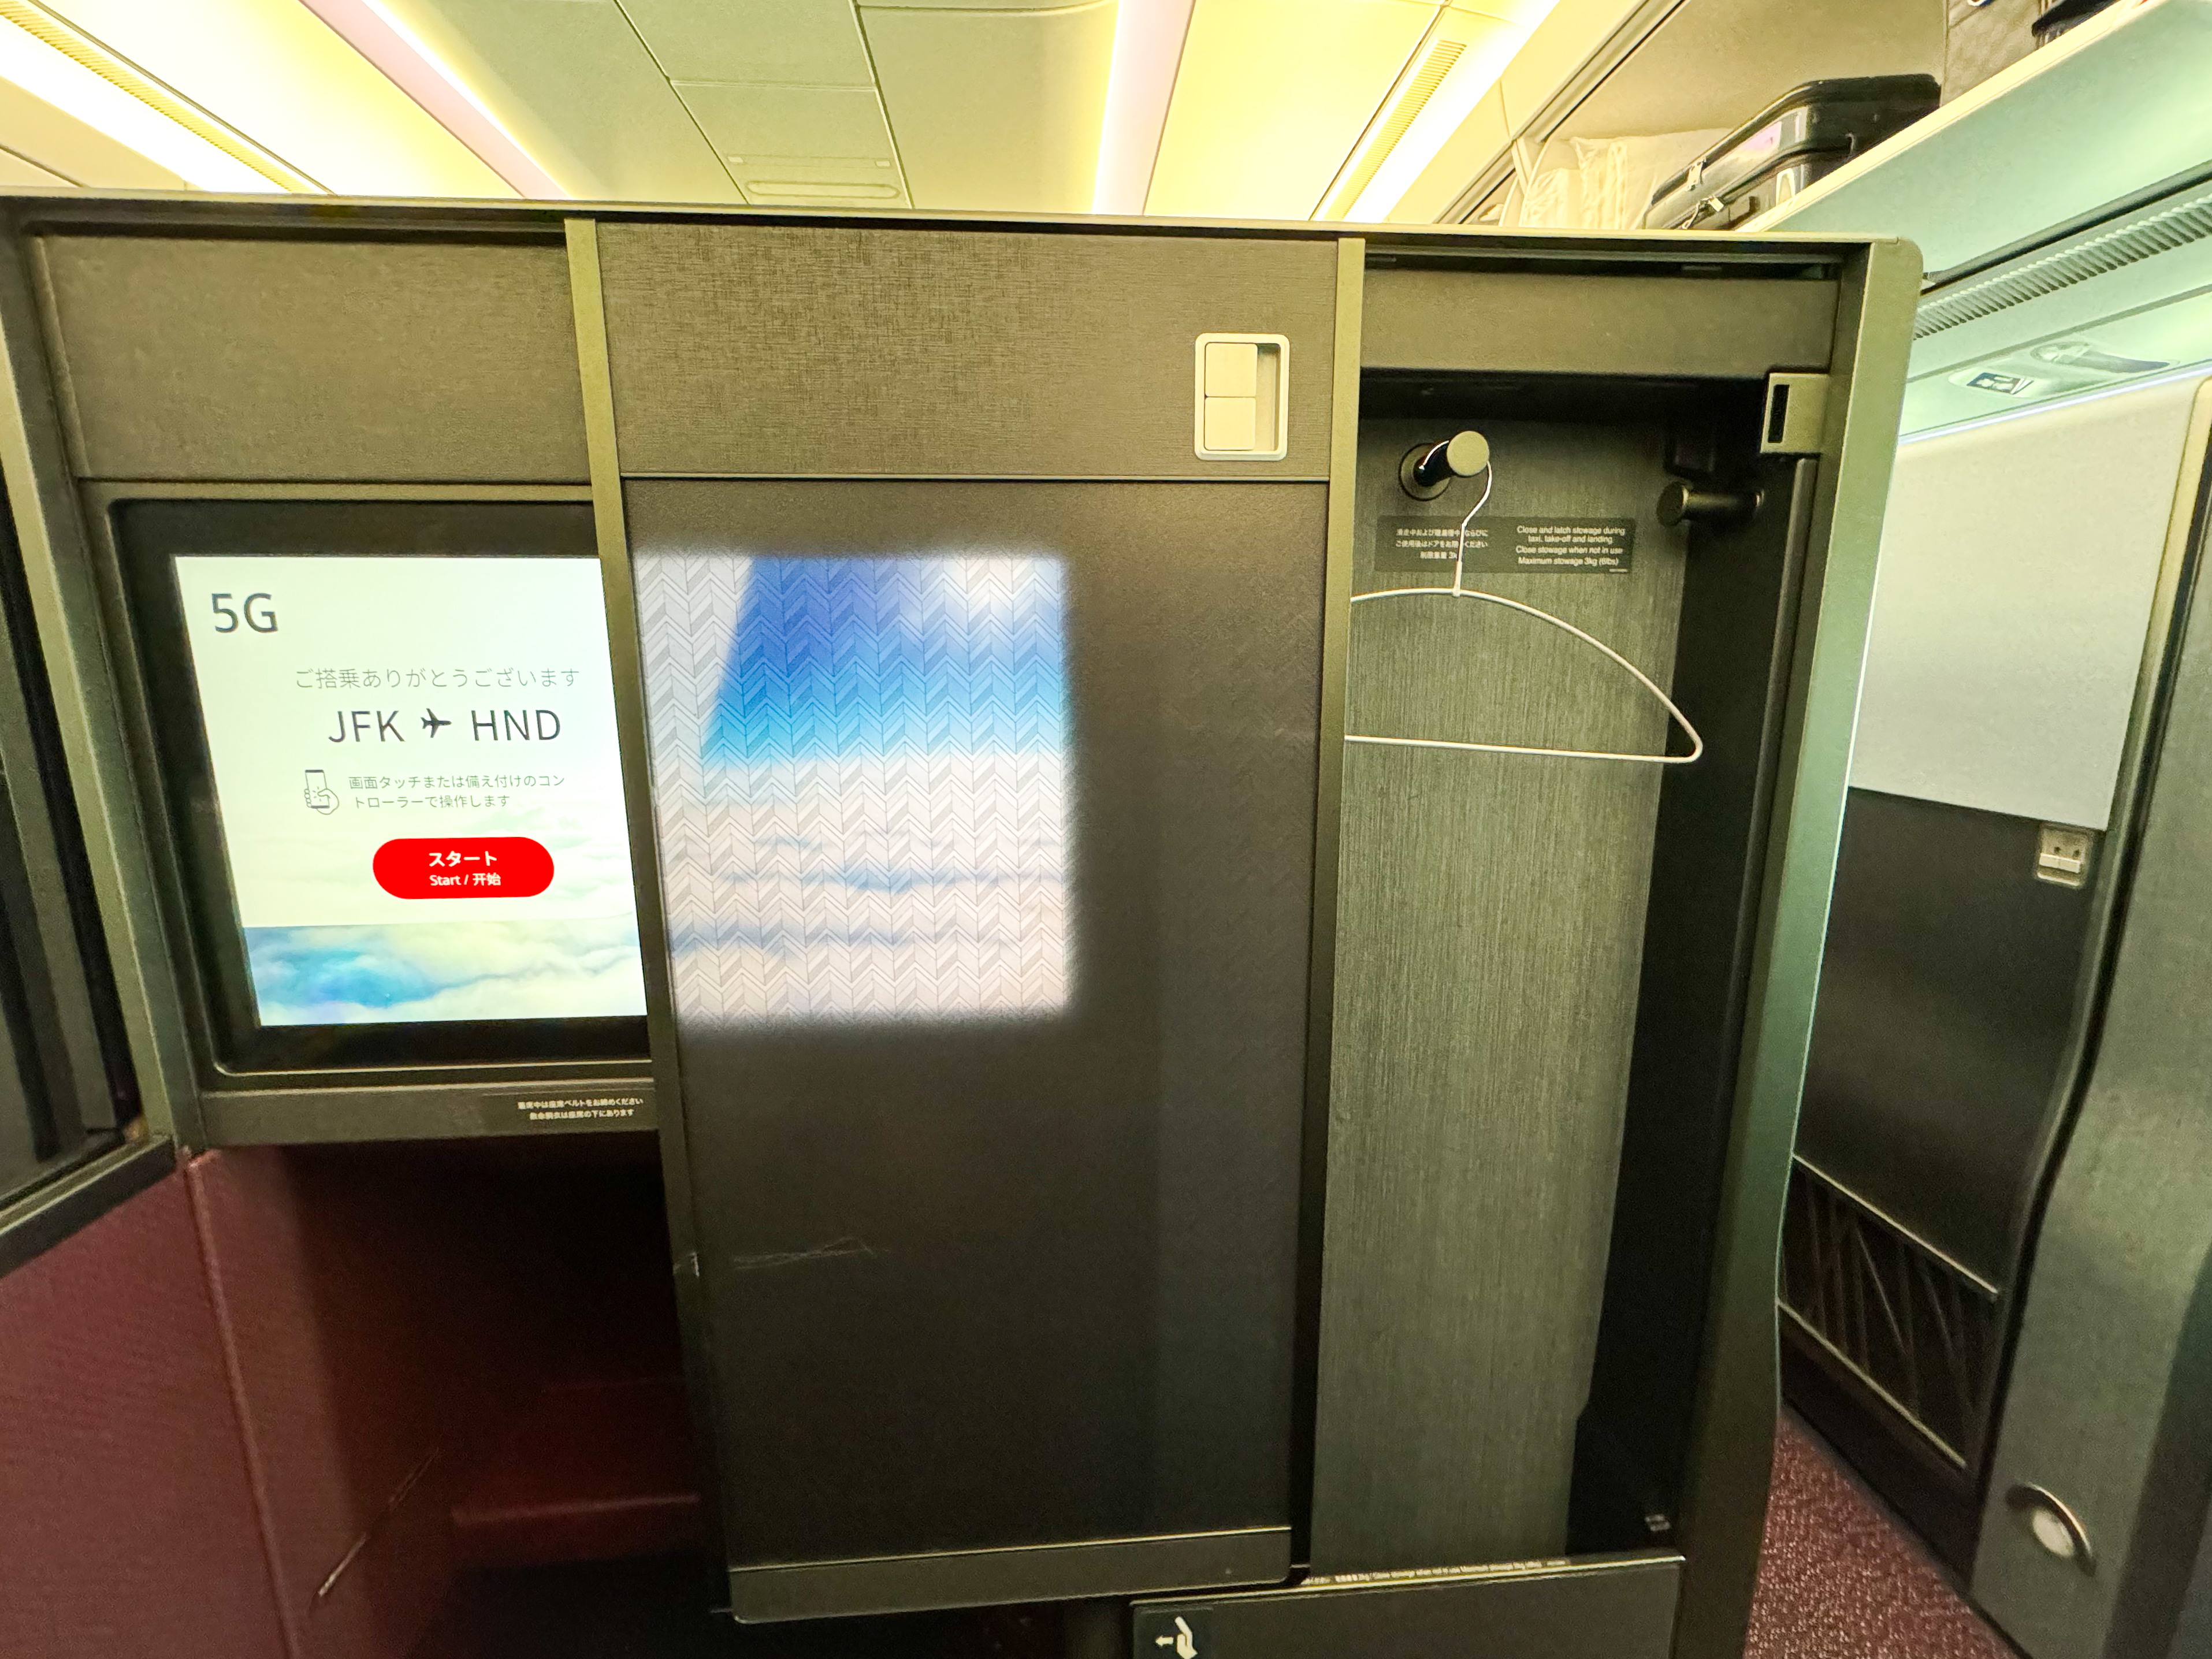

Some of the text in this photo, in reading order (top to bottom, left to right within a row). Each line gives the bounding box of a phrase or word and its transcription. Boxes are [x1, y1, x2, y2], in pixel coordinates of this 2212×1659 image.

[1516, 525, 1626, 536] Close and latch stowage during
[1544, 534, 1571, 543] take-off
[1572, 535, 1586, 543] and
[1588, 535, 1613, 545] landing
[1515, 545, 1537, 554] Close
[1537, 545, 1567, 555] stowage
[1518, 556, 1619, 567] Maximum stowage 3kg (6lbs)
[211, 593, 278, 634] 5G
[295, 667, 580, 690] ご搭乗ありがとうございます
[328, 709, 561, 743] JFK HND
[348, 774, 566, 790] 画面タッチまたは備え付けのコン
[354, 794, 511, 809] トローラーで操作します
[429, 851, 497, 867] スタート
[429, 873, 461, 886] Start
[473, 872, 501, 887] 开始
